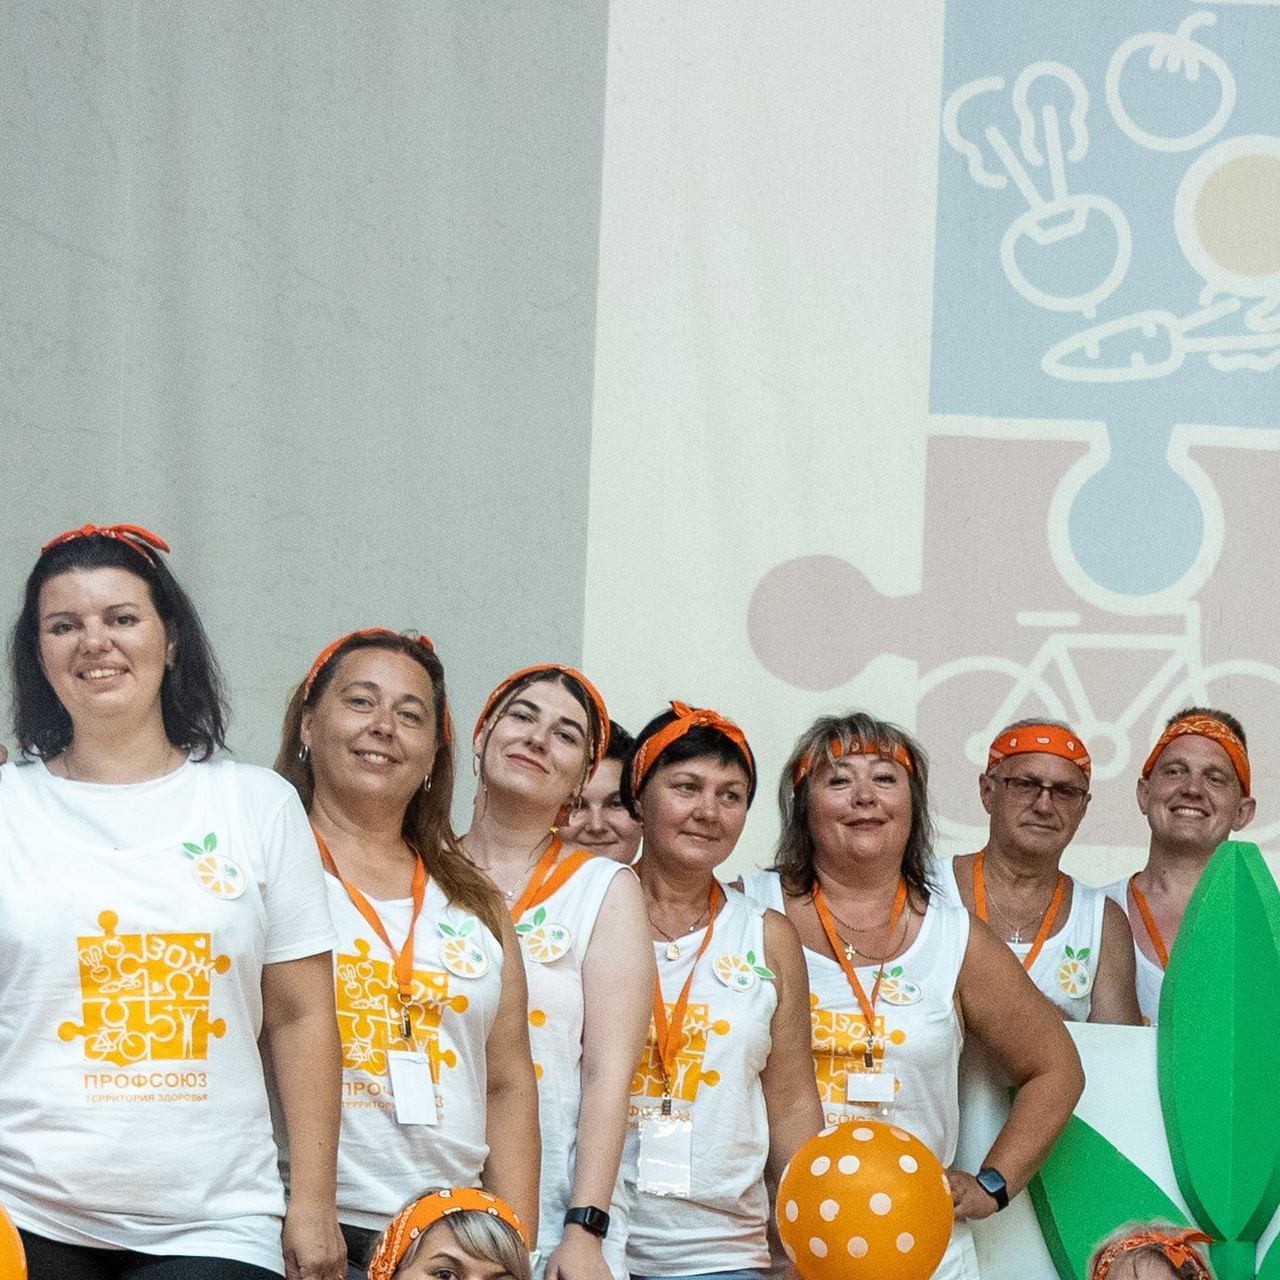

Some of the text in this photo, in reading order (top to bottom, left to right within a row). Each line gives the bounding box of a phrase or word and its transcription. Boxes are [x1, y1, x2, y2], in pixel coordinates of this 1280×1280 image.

[145, 937, 215, 982] ЗОЖ
[84, 1072, 208, 1089] ПРОФСОЮЗ
[86, 1093, 209, 1103] ТЕРРИТОРИЯ ЗДОРОВЬЯ
